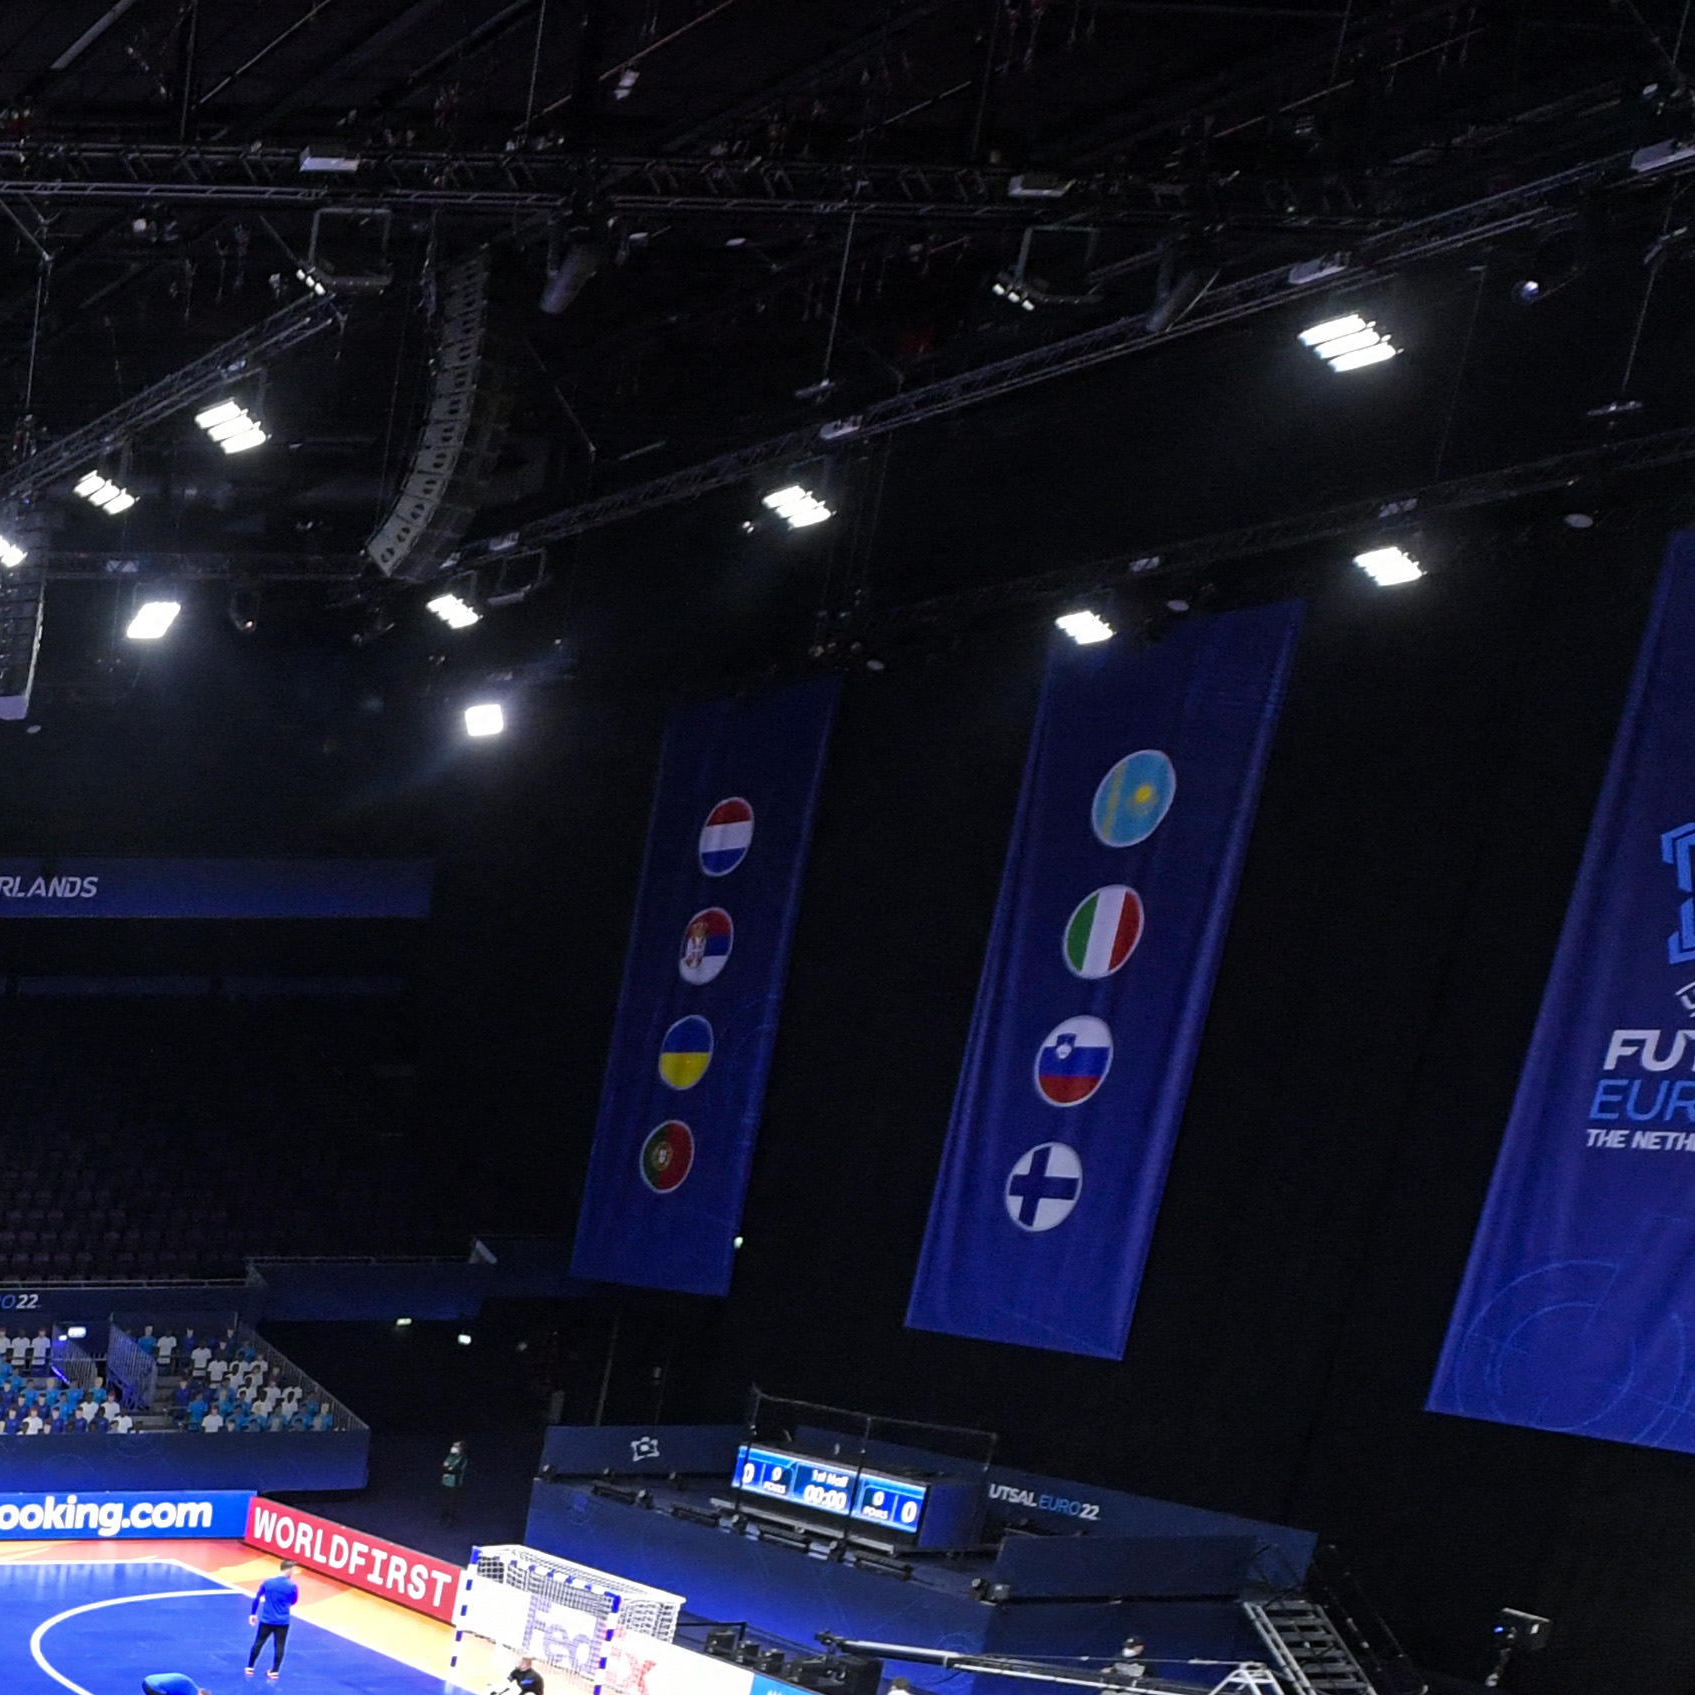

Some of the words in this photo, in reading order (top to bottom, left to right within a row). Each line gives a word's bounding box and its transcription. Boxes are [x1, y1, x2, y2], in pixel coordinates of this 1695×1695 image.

[1586, 1128, 1630, 1149] THE
[803, 1485, 847, 1511] 00:00
[988, 1483, 1037, 1507] UTSAL
[901, 1501, 918, 1524] 0
[253, 1506, 452, 1608] WORLDFIRST
